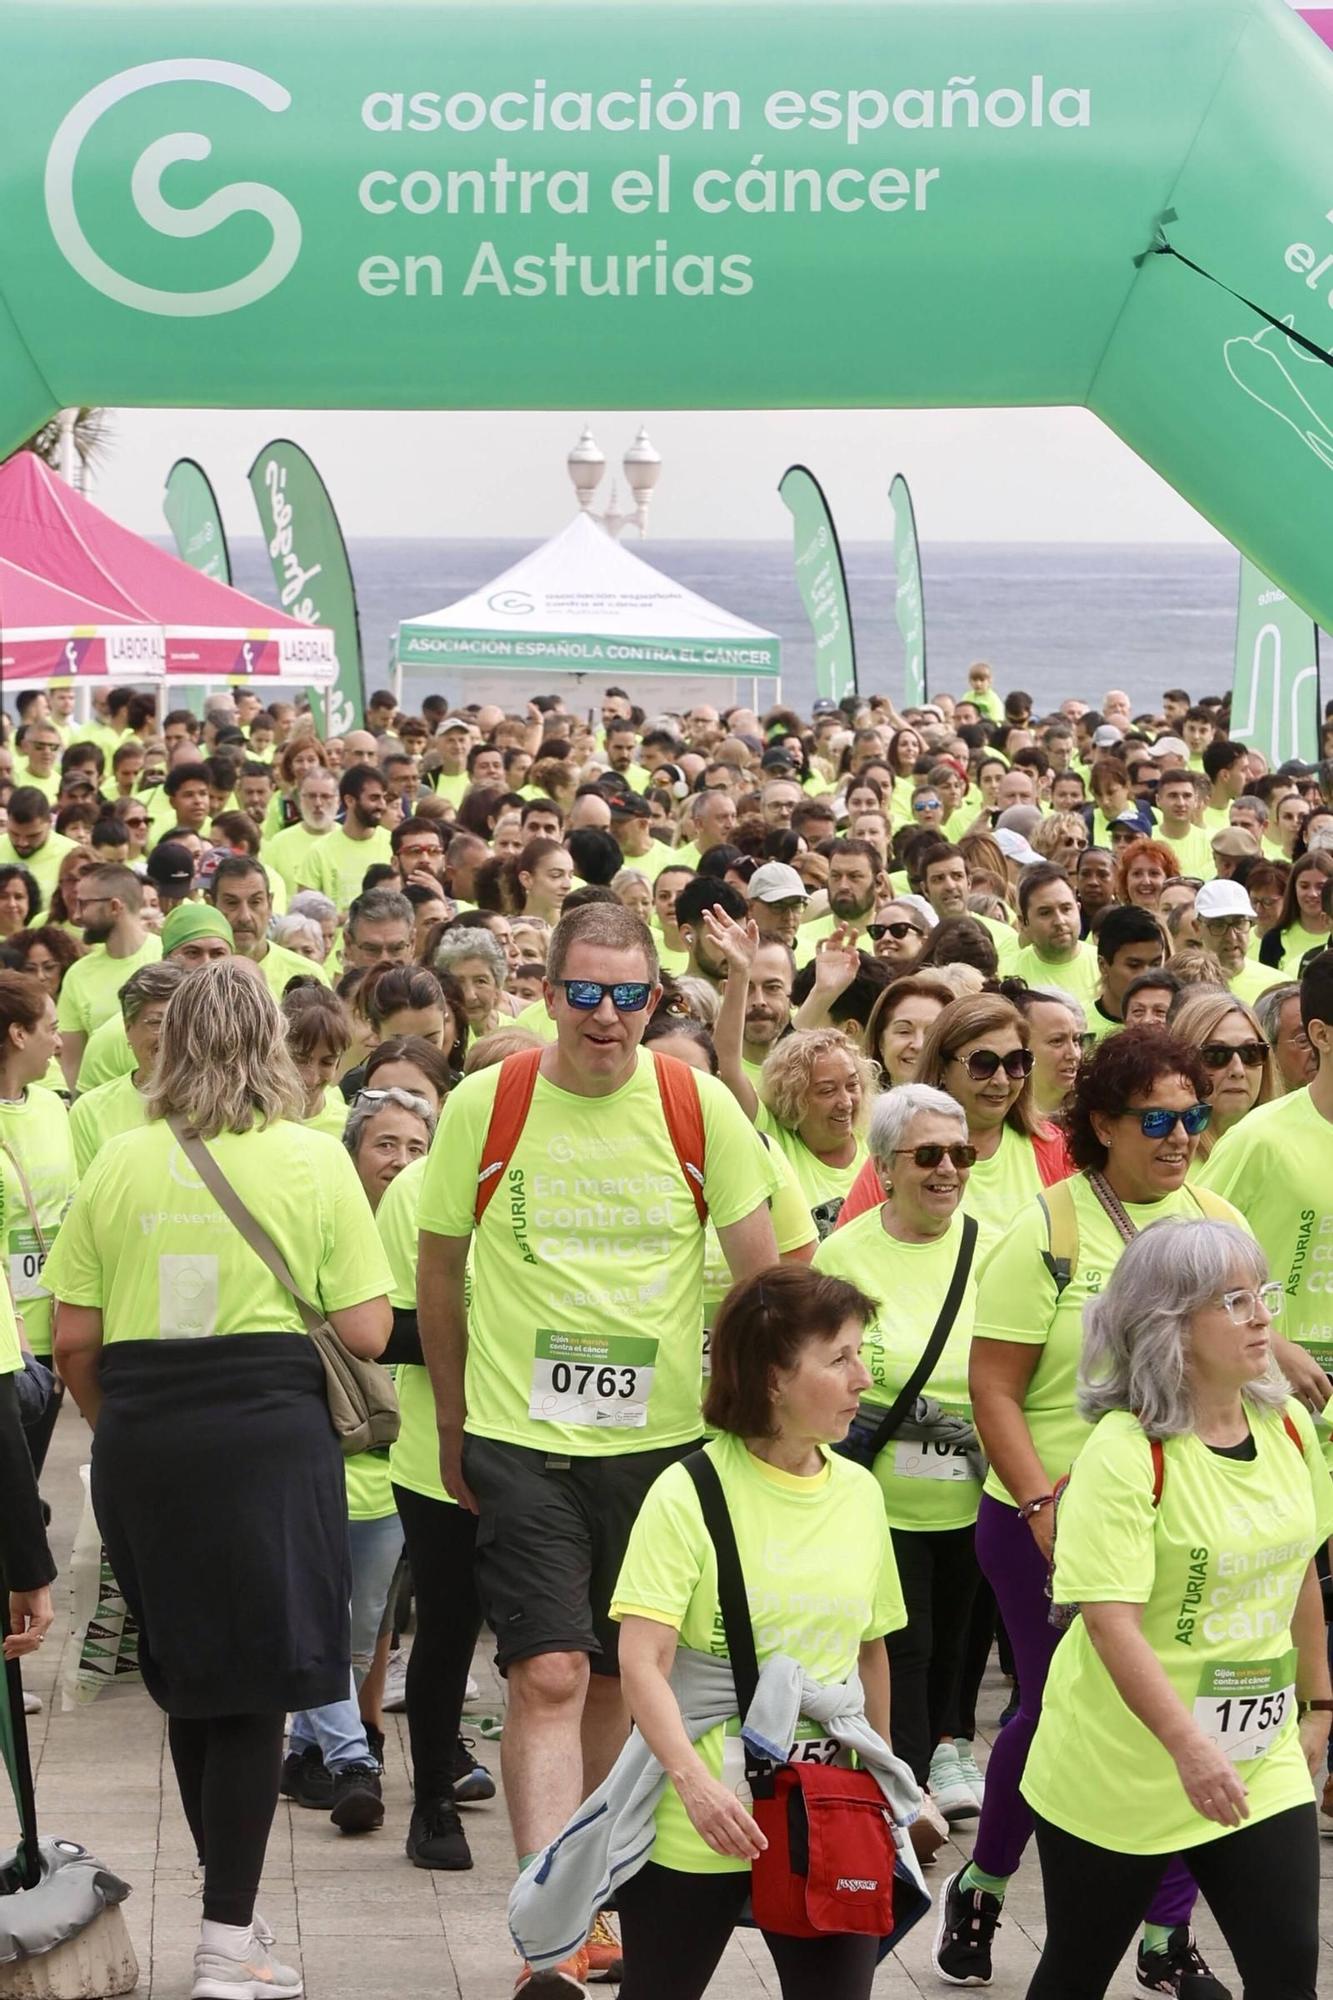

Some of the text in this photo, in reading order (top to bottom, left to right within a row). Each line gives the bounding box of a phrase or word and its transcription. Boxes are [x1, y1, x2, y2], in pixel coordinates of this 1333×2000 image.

[361, 75, 1092, 145] asociación española
[358, 154, 941, 215] contra el cáncer
[358, 239, 755, 297] en Asturias
[407, 637, 772, 666] ASOCIACIÓN ESPAÑOLA CONTRA EL CÁNCER
[532, 1171, 676, 1199] En marcha
[508, 1168, 538, 1266] ASTURIAS
[534, 1199, 674, 1229] contra el
[1285, 1208, 1316, 1297] ASTURIAS
[551, 1362, 637, 1399] 0763
[1216, 1550, 1250, 1577] En
[1174, 1546, 1209, 1646] ASTURIAS
[757, 1623, 845, 1654] ontra
[1215, 1691, 1286, 1733] 1753
